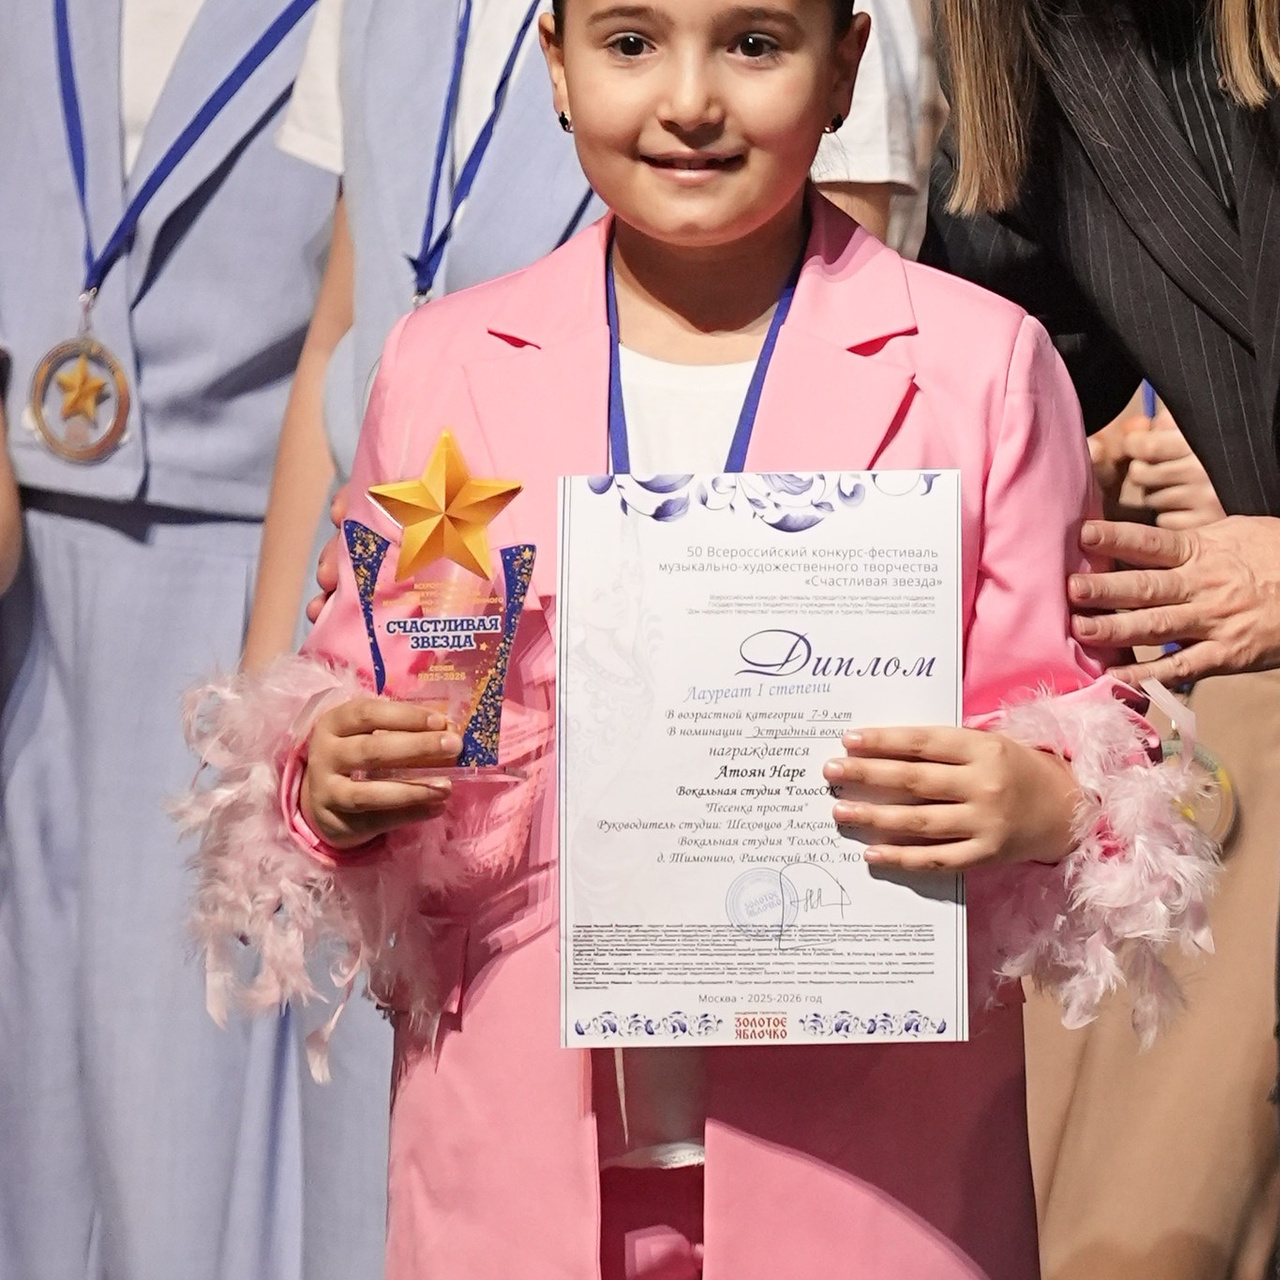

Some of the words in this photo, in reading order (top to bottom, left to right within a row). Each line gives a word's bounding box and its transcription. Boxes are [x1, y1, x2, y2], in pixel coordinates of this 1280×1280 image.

[686, 545, 703, 558] 50
[707, 545, 807, 559] Всероссийский
[811, 546, 939, 560] конкурс-фестиваль
[658, 562, 859, 575] музыкально-художественного
[863, 563, 938, 574] творчества
[804, 575, 888, 587] «Счастливая
[892, 577, 943, 588] звезда»
[386, 617, 500, 634] СЧАСТЛИВАЯ
[410, 634, 475, 650] ЗВЕЗДА
[734, 628, 936, 679] Диплом
[683, 683, 752, 705] Лауреат
[769, 681, 832, 698] степени
[665, 709, 676, 721] В
[677, 709, 742, 723] возрастной
[744, 710, 804, 725] категории
[811, 709, 829, 720] 7-9
[830, 711, 852, 720] лет
[666, 726, 677, 737] В
[677, 728, 743, 739] номинации
[753, 725, 817, 739] Эстрадный
[819, 727, 850, 738] вока
[709, 743, 810, 760] награждается
[714, 765, 766, 780] Атоян
[769, 765, 806, 782] Наре
[675, 785, 737, 797] Вокальная
[740, 787, 781, 800] студия
[705, 802, 753, 815] "Песенка
[756, 803, 809, 816] простая"
[597, 819, 676, 832] Руководитель
[678, 820, 722, 833] студии:
[726, 819, 782, 831] Шеховцов
[678, 836, 739, 847] Вокальная
[741, 837, 783, 850] студия
[657, 852, 666, 864] д.
[669, 852, 735, 865] Тимонино,
[739, 852, 801, 866] Раменский
[698, 994, 737, 1003] Москва
[747, 993, 803, 1003] 2025-2026
[804, 995, 823, 1004] год
[734, 1017, 787, 1028] ЗОЛОТОЕ
[735, 1028, 788, 1040] ЯБЛОЧКО
